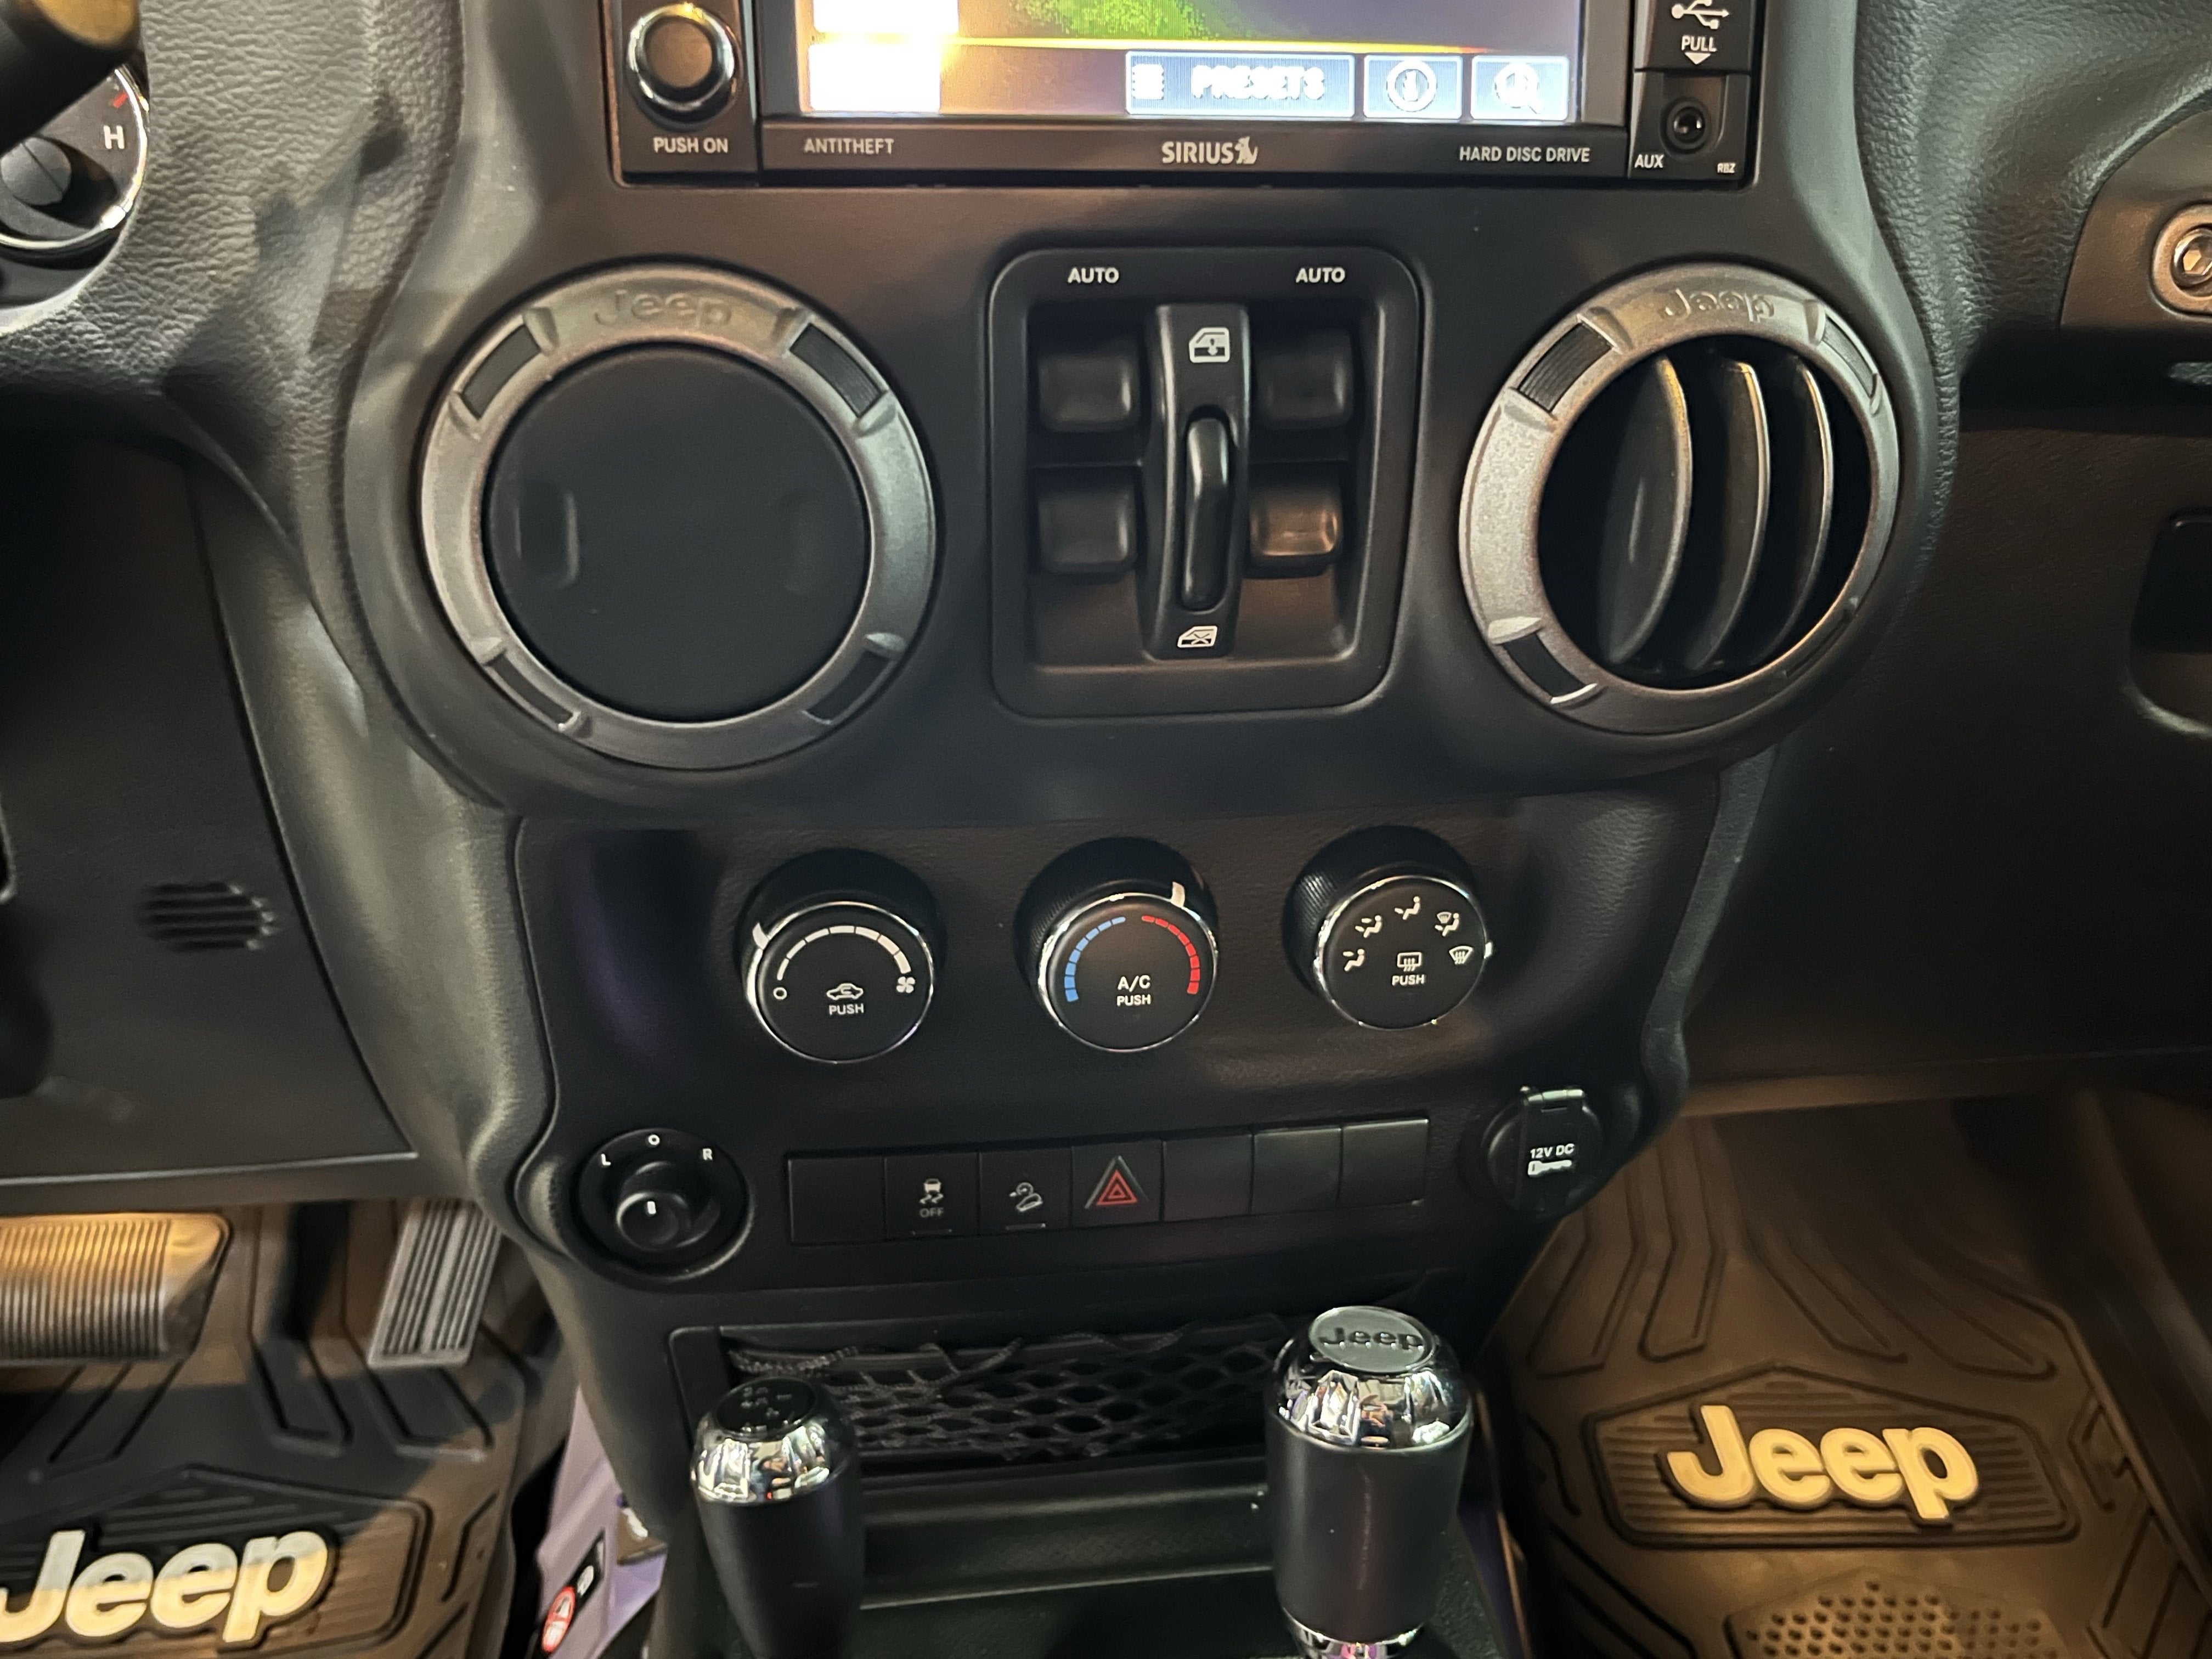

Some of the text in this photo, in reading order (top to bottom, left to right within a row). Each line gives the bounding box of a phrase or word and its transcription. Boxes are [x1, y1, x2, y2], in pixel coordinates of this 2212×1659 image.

[1681, 35, 1717, 53] PULL
[1192, 64, 1325, 100] PRESETS
[103, 125, 125, 150] H
[653, 137, 728, 154] PUSH ON
[804, 137, 894, 155] ANTITHEFT
[1161, 141, 1234, 164] SIRIUS
[1459, 145, 1590, 162] HARD DISC DRIVE
[1634, 154, 1664, 168] AUX
[1068, 267, 1119, 284] AUTO
[1295, 267, 1346, 284] AUTO
[594, 289, 732, 329] Jeep
[1663, 287, 1775, 323] Jeep
[1117, 974, 1151, 991] A/C
[1391, 973, 1425, 986] PUSH
[1116, 994, 1152, 1006] PUSH
[828, 1003, 864, 1015] PUSH
[601, 1153, 611, 1166] L
[702, 1148, 713, 1161] R
[1530, 1143, 1575, 1159] 12V DC
[919, 1207, 945, 1218] OFF
[1318, 1327, 1425, 1352] Jeep
[1666, 1404, 1978, 1521] Jeep
[0, 1528, 329, 1644] Jeep
